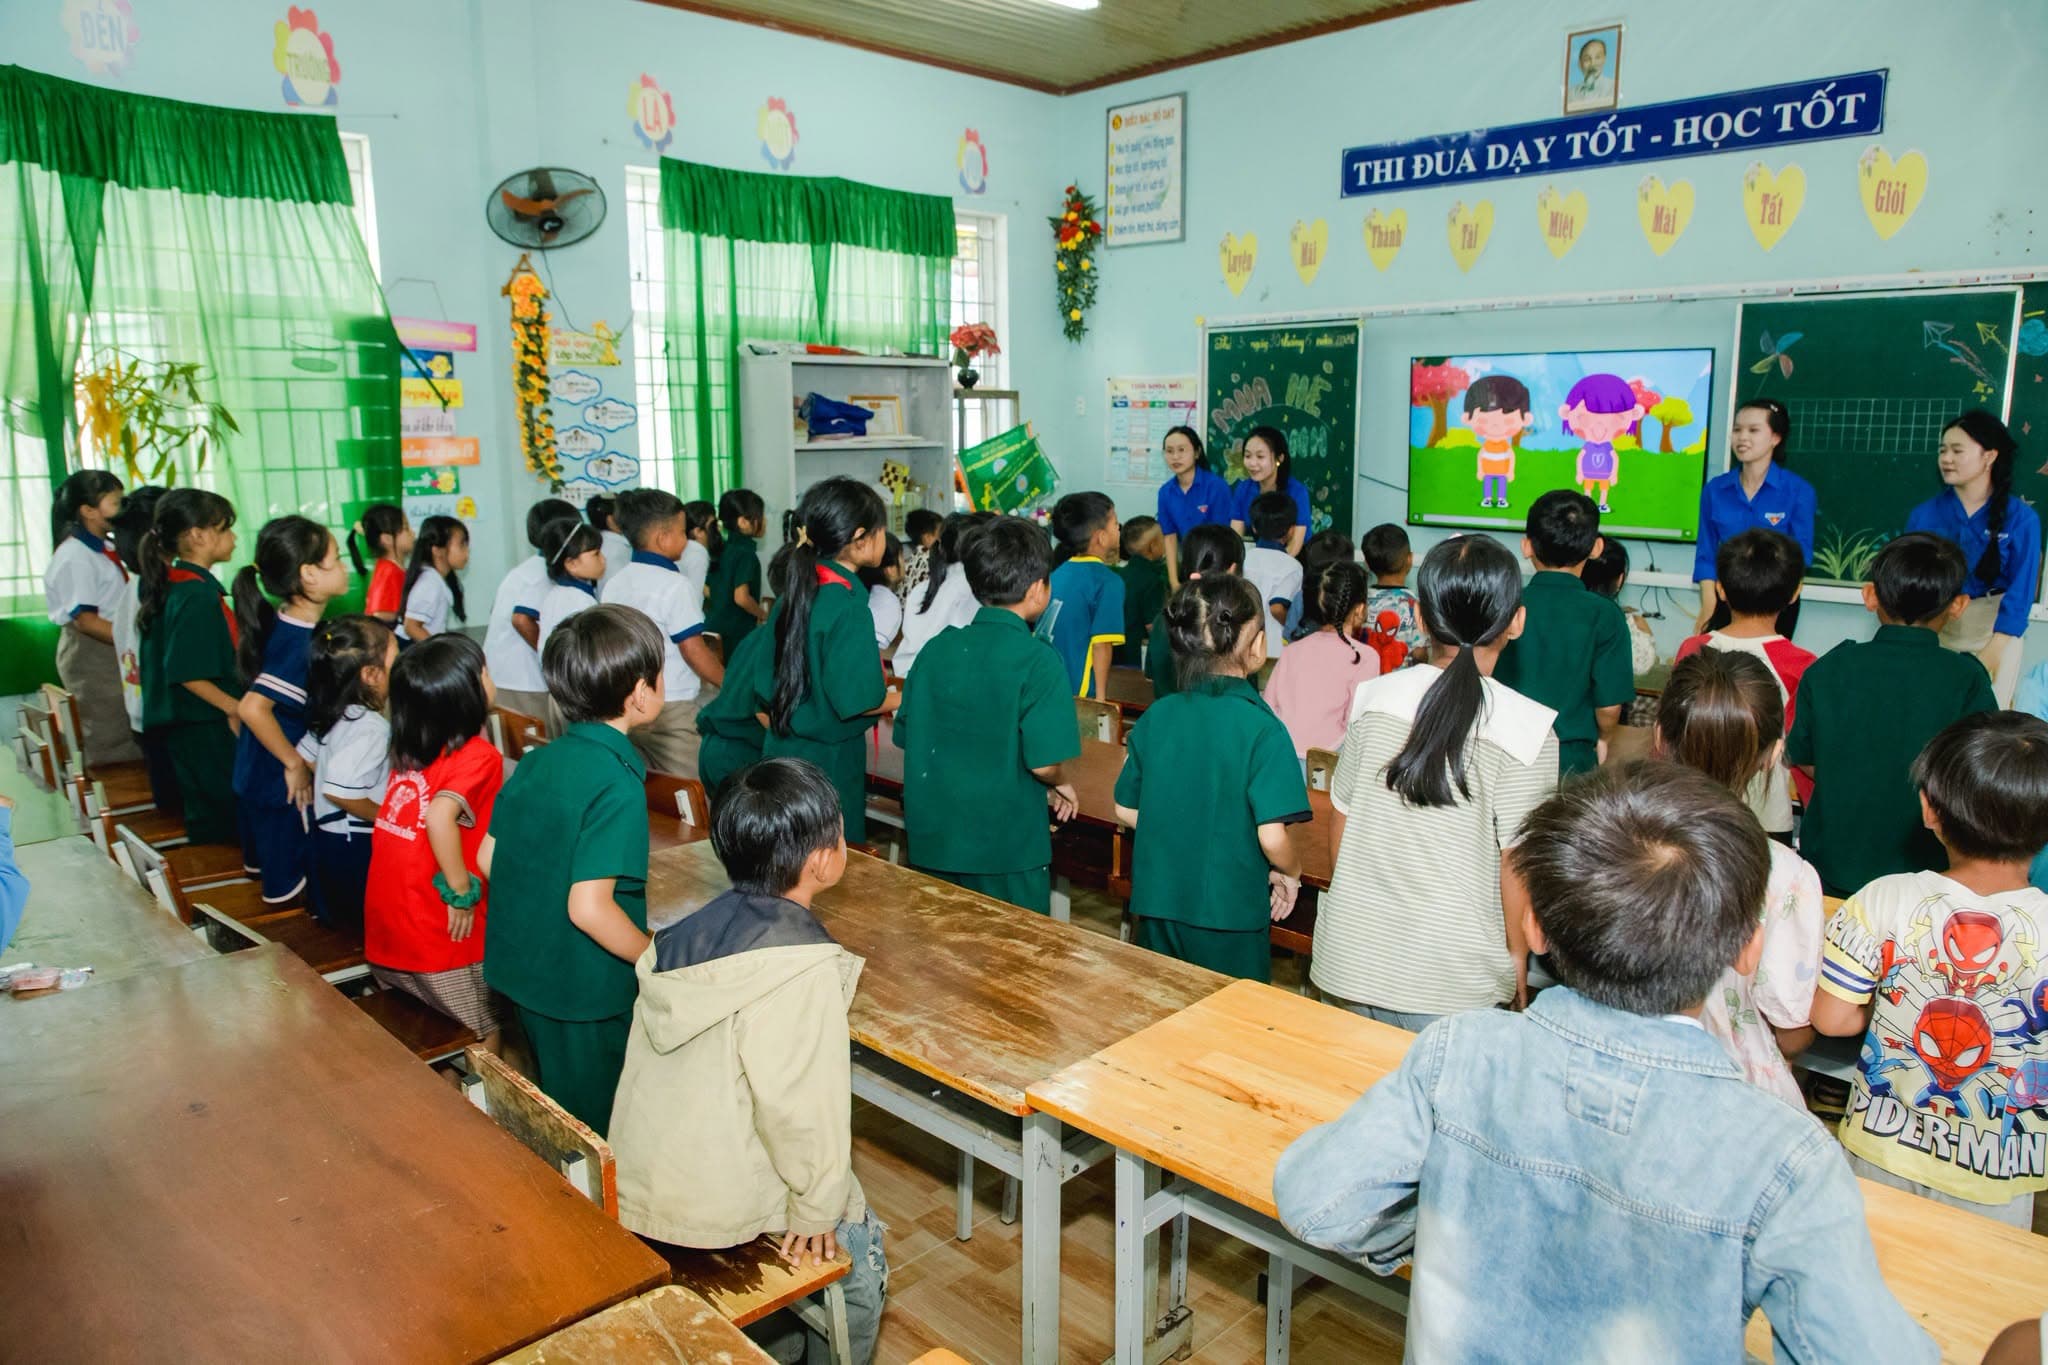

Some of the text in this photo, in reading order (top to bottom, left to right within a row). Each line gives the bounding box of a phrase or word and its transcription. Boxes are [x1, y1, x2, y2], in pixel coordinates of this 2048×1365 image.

[1354, 157, 1404, 187] THI
[1413, 148, 1476, 179] ĐUA
[1486, 136, 1557, 174] DẠY
[1566, 114, 1641, 160] TỐT
[1673, 107, 1762, 149] HỌC
[1773, 82, 1866, 132] TỐT
[1547, 209, 1574, 244] Miệt
[1651, 203, 1677, 236] Mài
[1760, 191, 1784, 227] Tất
[1874, 178, 1908, 216] Giỏi
